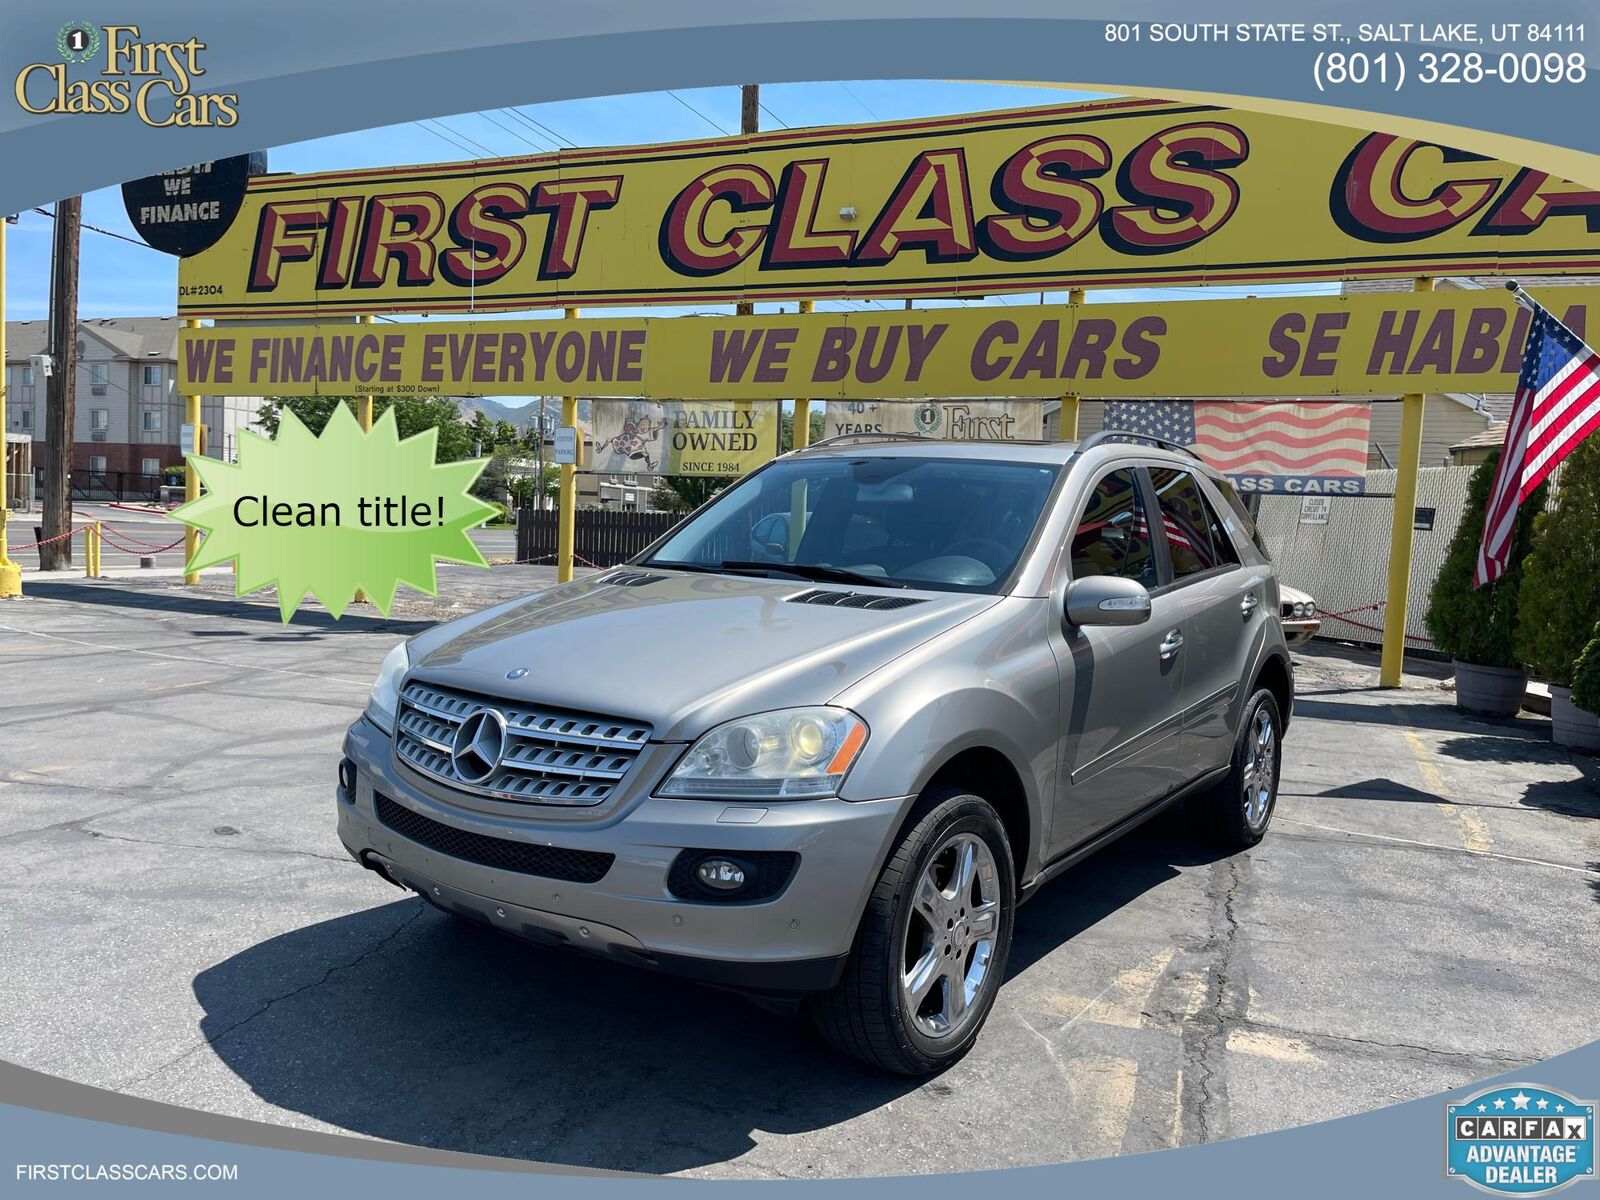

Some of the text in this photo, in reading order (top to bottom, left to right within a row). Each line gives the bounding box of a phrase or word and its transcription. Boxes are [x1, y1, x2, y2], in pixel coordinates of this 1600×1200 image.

[163, 176, 192, 196] WE
[140, 201, 220, 225] FINANCE
[246, 175, 624, 293] FIRST
[658, 122, 1249, 277] CLASS
[179, 284, 223, 296] DL#2304
[709, 316, 1168, 383] WE BUY CARS
[1261, 312, 1350, 378] SE
[185, 330, 647, 383] WE FINANCE EVERYONE
[355, 384, 440, 394] (Starting at $300 Down)
[847, 401, 865, 415] 40
[672, 410, 758, 429] FAMILY
[942, 405, 1016, 439] First
[835, 423, 883, 436] YEARS
[672, 432, 758, 451] OWNED
[682, 461, 740, 472] SINCE 1984
[1284, 478, 1360, 493] CARS
